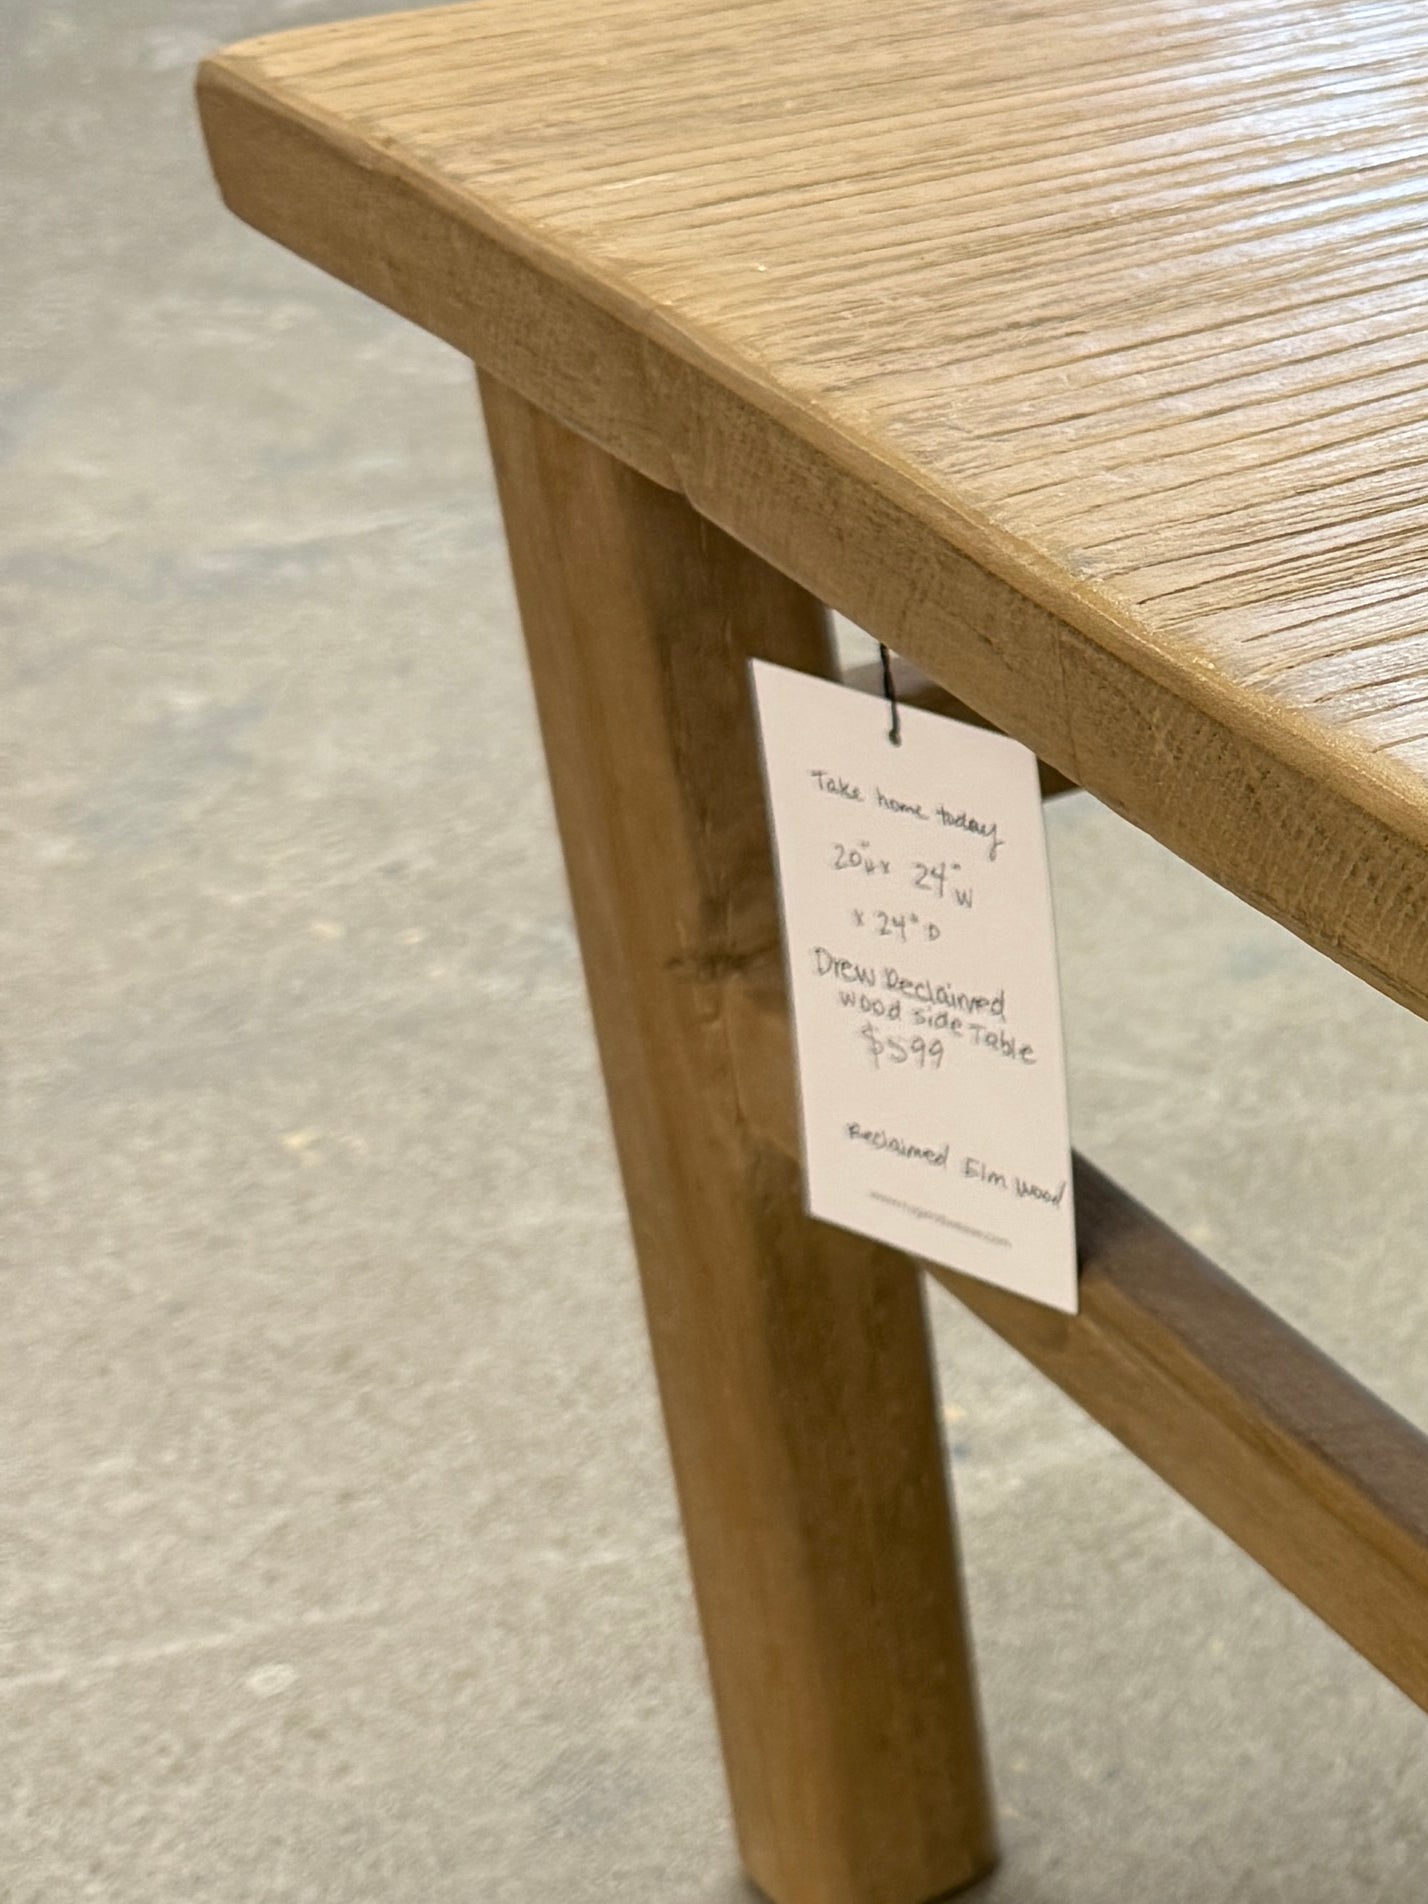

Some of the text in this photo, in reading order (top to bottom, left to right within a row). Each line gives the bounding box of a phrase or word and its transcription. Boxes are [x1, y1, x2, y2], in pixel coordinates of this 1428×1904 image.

[810, 769, 864, 802] Take
[877, 787, 929, 820] home
[814, 946, 877, 987] Drew
[860, 1022, 945, 1070] $599
[968, 1022, 1038, 1066] Table
[962, 1156, 1007, 1190] Elm
